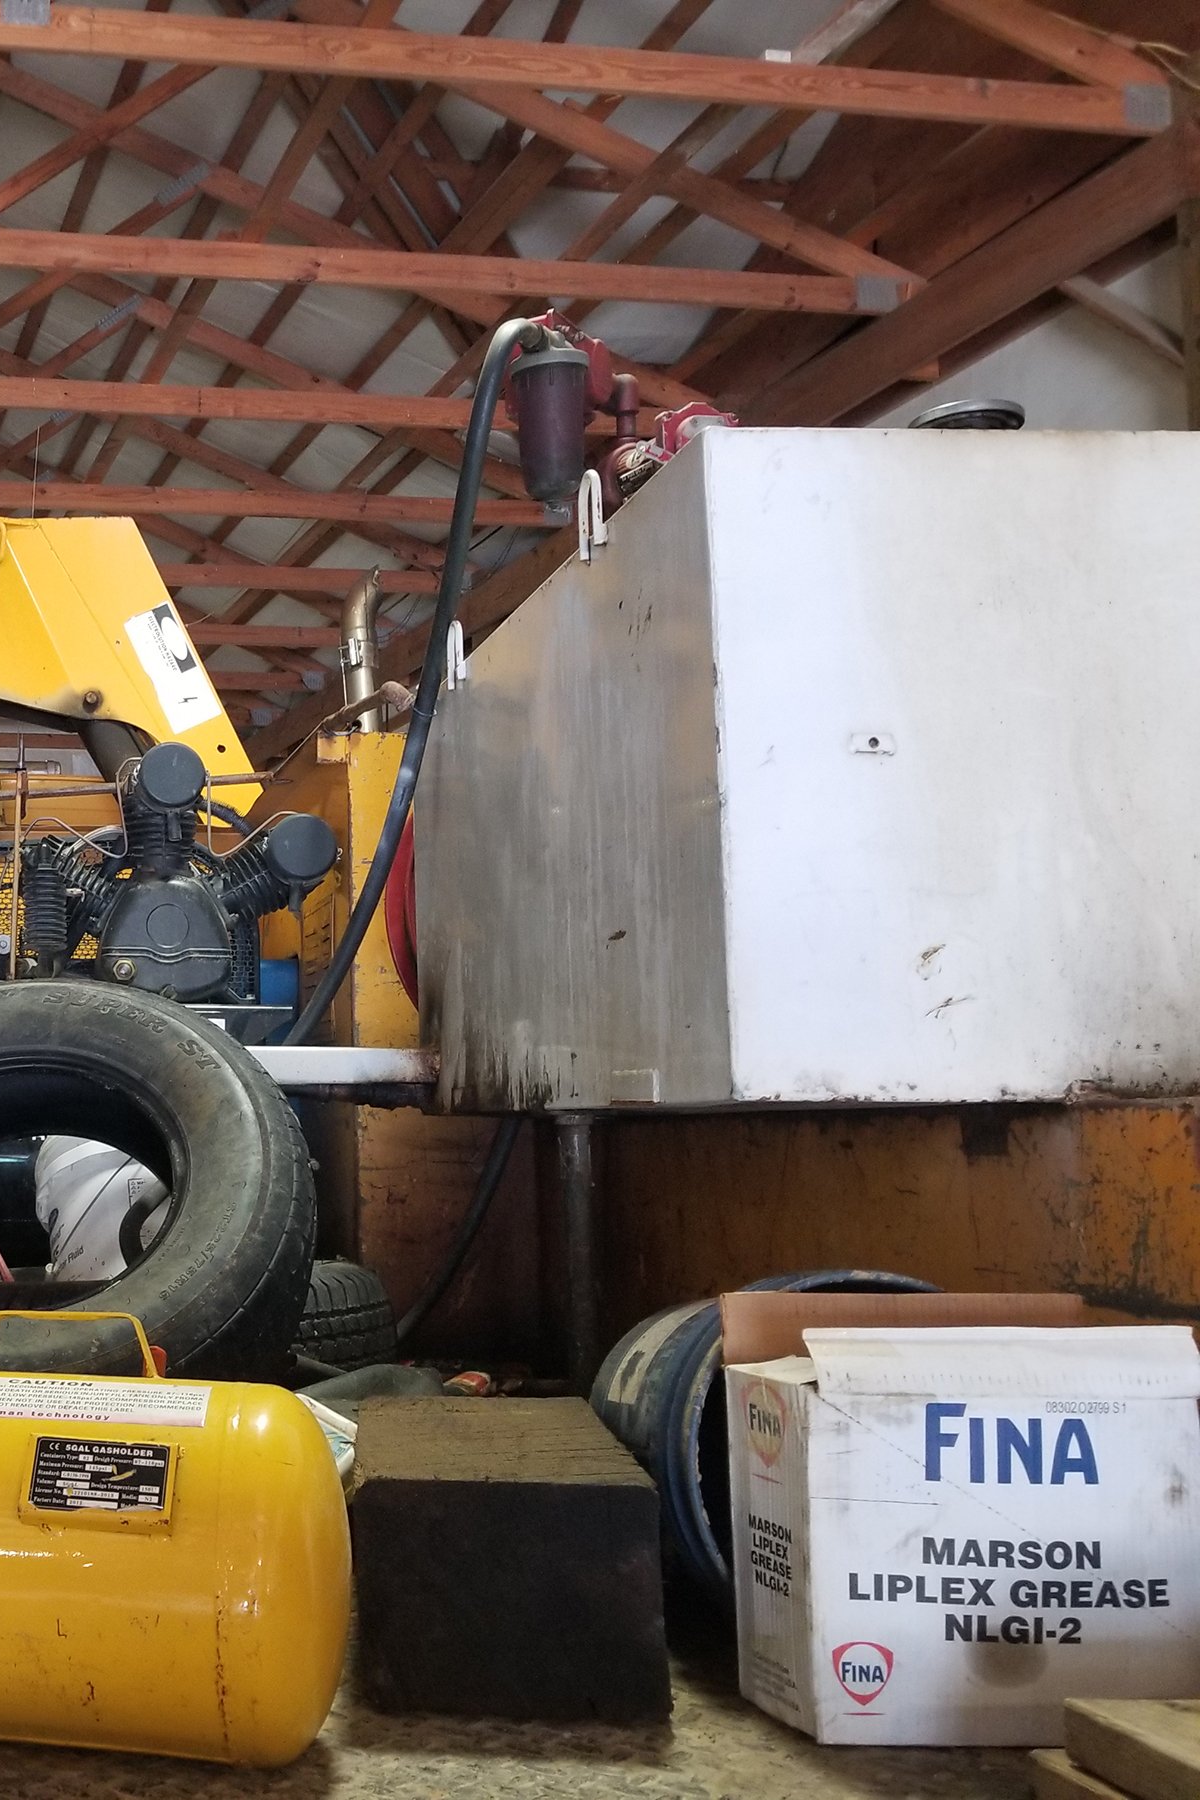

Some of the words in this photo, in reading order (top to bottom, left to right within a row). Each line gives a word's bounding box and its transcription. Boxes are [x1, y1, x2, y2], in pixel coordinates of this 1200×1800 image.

[32, 1411, 110, 1421] technology
[749, 1402, 783, 1437] FINA
[66, 1444, 90, 1452] 5GAL
[92, 1446, 153, 1457] GASHOLDER
[924, 1402, 1099, 1485] FINA
[748, 1514, 792, 1543] MARSON
[752, 1533, 789, 1562] LIPLEX
[922, 1537, 1101, 1570] MARSON
[750, 1551, 792, 1581] GREASE
[754, 1572, 790, 1597] NLGI-2
[848, 1573, 996, 1606] LIPLEX
[1009, 1579, 1170, 1608] GREASE
[944, 1614, 1081, 1644] NLGI-2
[840, 1661, 884, 1684] FINA
